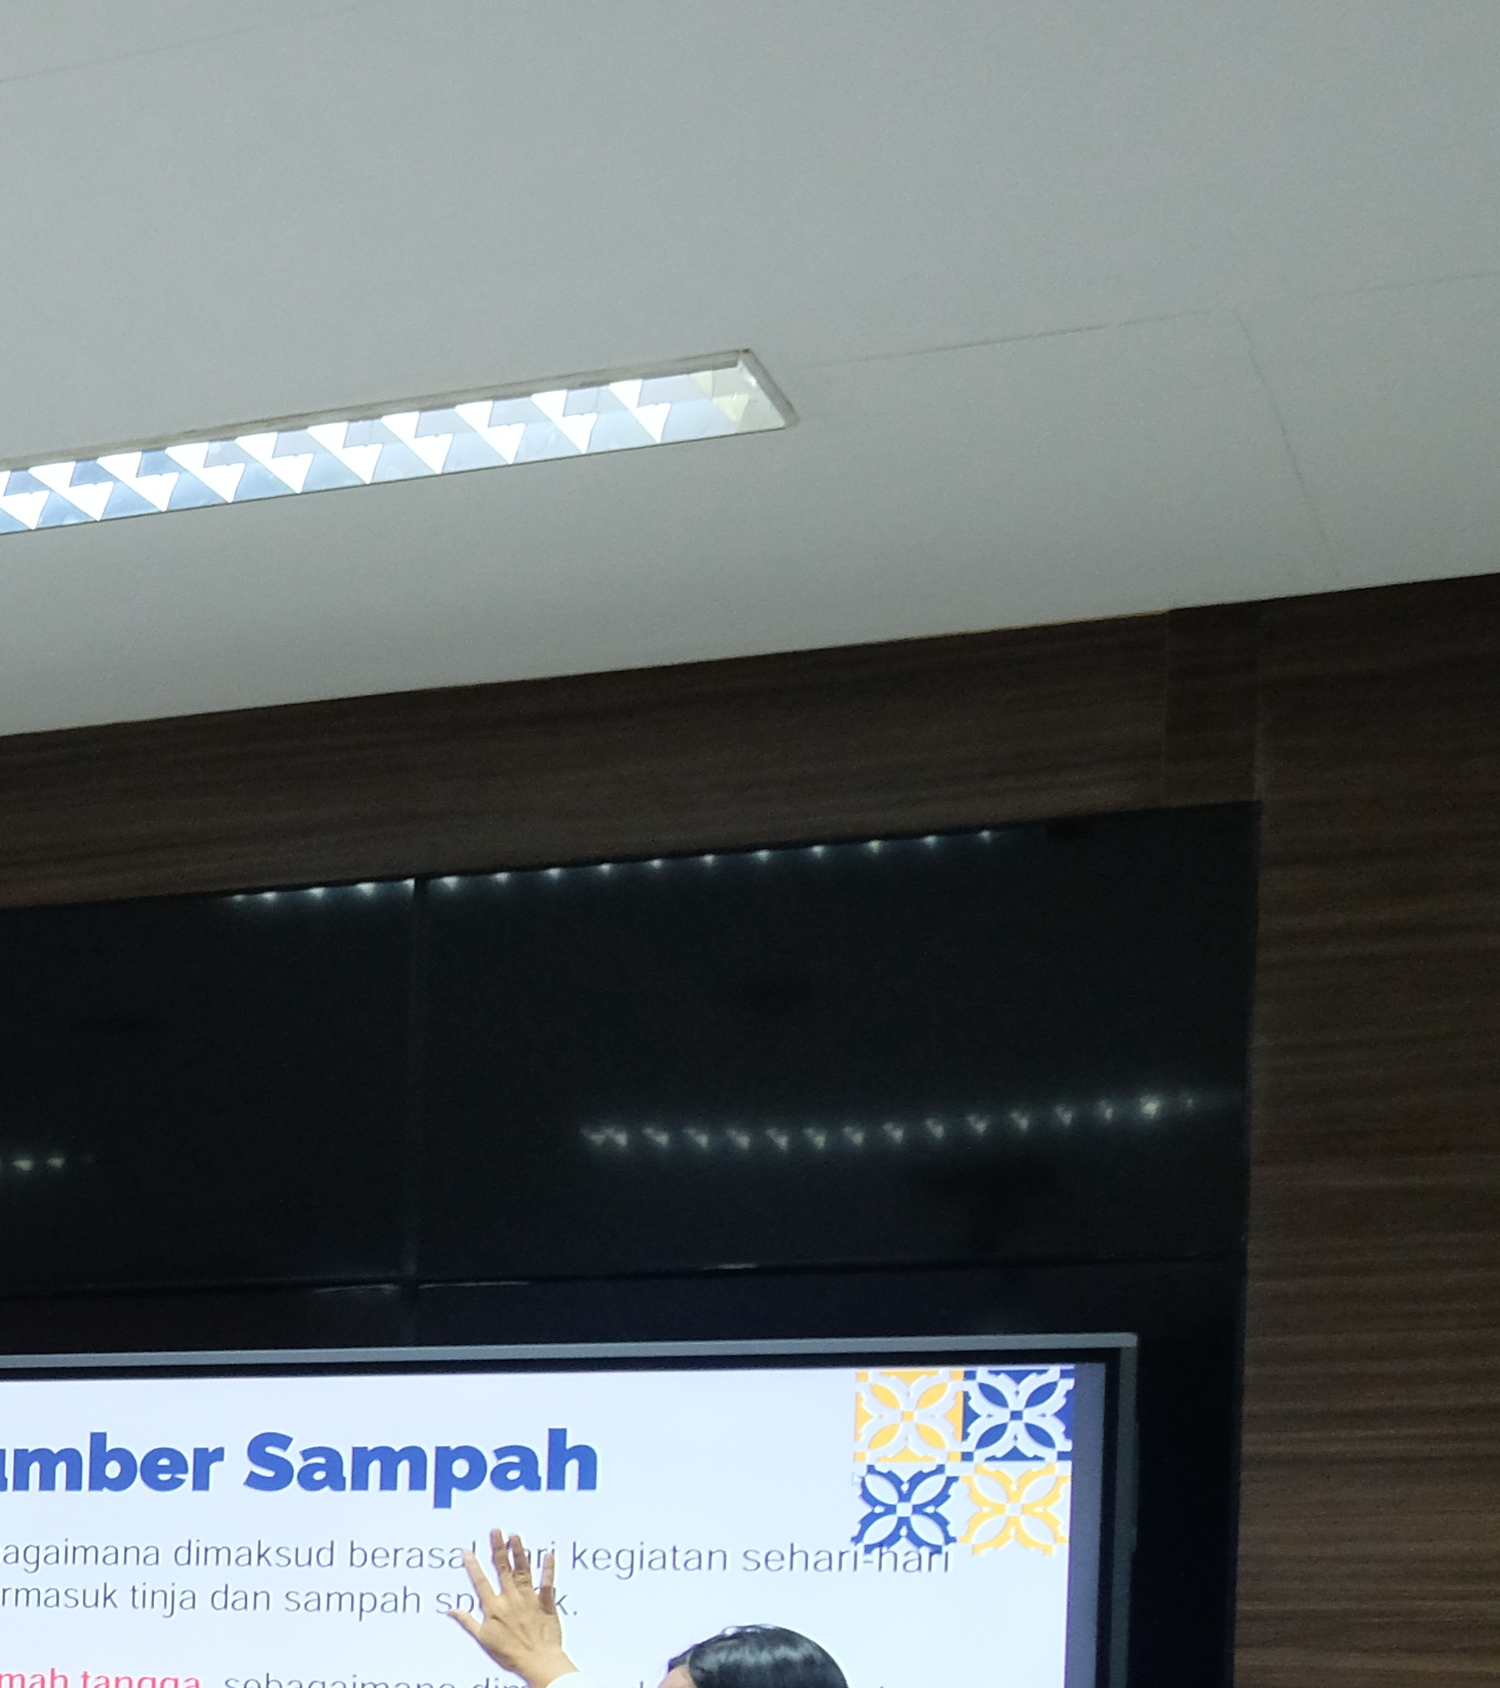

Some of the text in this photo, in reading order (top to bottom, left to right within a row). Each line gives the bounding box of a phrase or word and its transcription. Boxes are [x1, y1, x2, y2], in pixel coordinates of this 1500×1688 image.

[244, 1428, 598, 1508] Sampah
[173, 1539, 335, 1568] dimaksud
[572, 1541, 728, 1580] kegiatan
[743, 1543, 950, 1574] sehari-hari
[131, 1582, 196, 1618] tinja
[211, 1584, 271, 1611] dan
[285, 1586, 420, 1622] sampah
